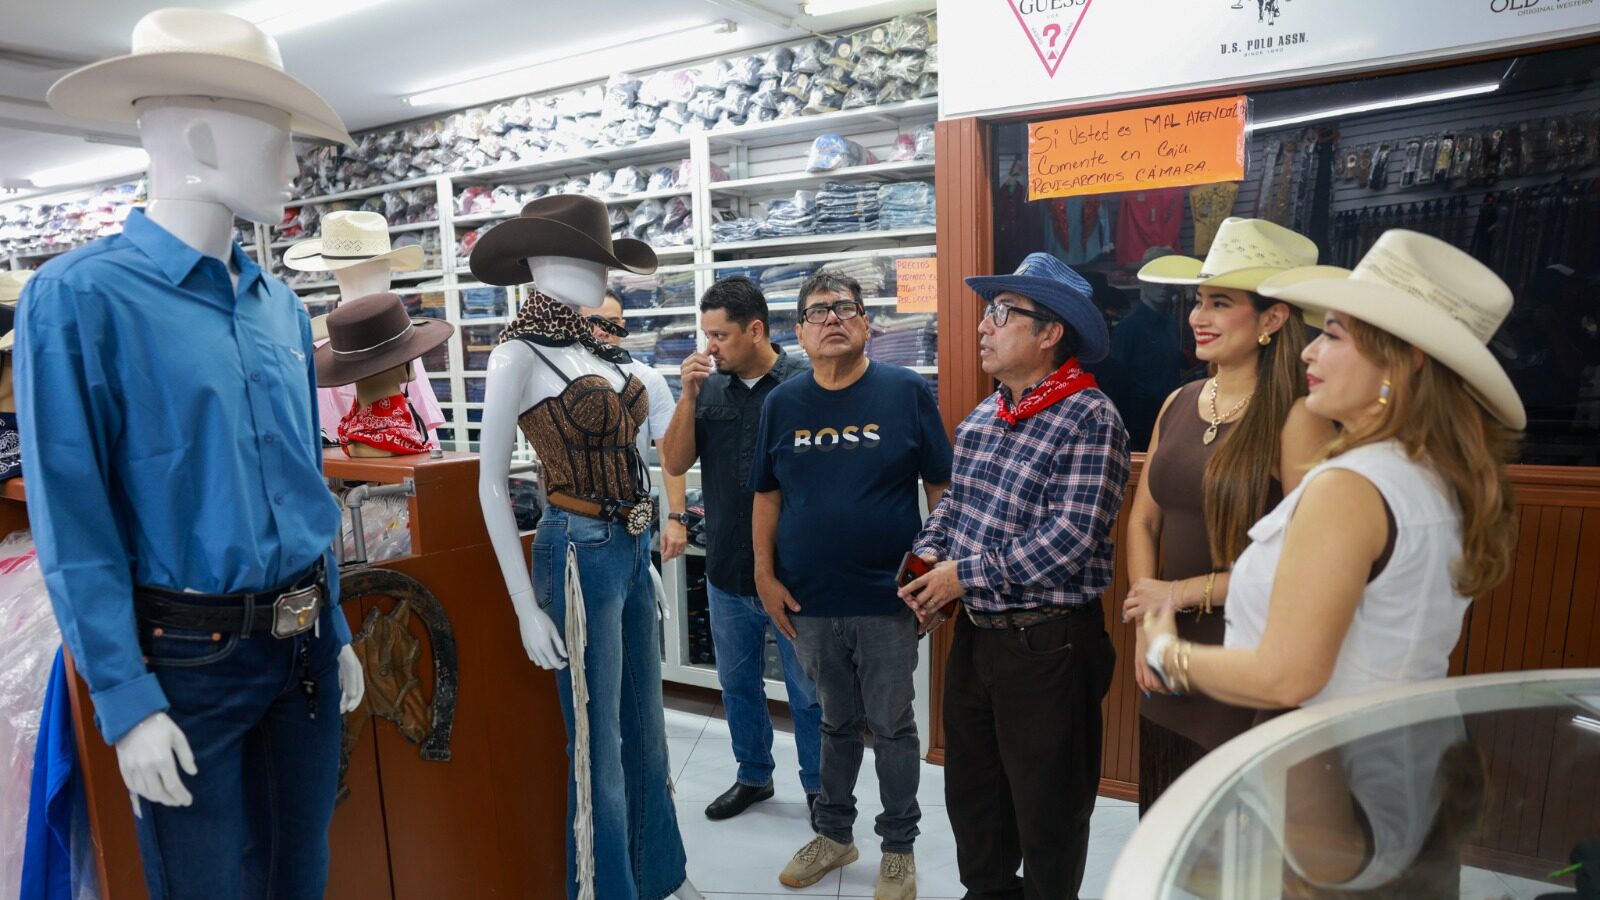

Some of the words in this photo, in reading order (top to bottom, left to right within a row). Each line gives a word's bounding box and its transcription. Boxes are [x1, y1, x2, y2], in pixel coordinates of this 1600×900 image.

[1517, 5, 1555, 16] ORIGINAL
[1220, 42, 1242, 54] U.S.
[1247, 37, 1273, 51] POLO
[1278, 32, 1309, 46] ASSN.
[1033, 126, 1059, 155] Si
[1069, 120, 1109, 145] Usted
[1117, 126, 1132, 137] es
[1144, 113, 1181, 133] MAL
[1037, 155, 1109, 176] Comente
[1120, 150, 1141, 161] en
[793, 423, 881, 453] BOSS
